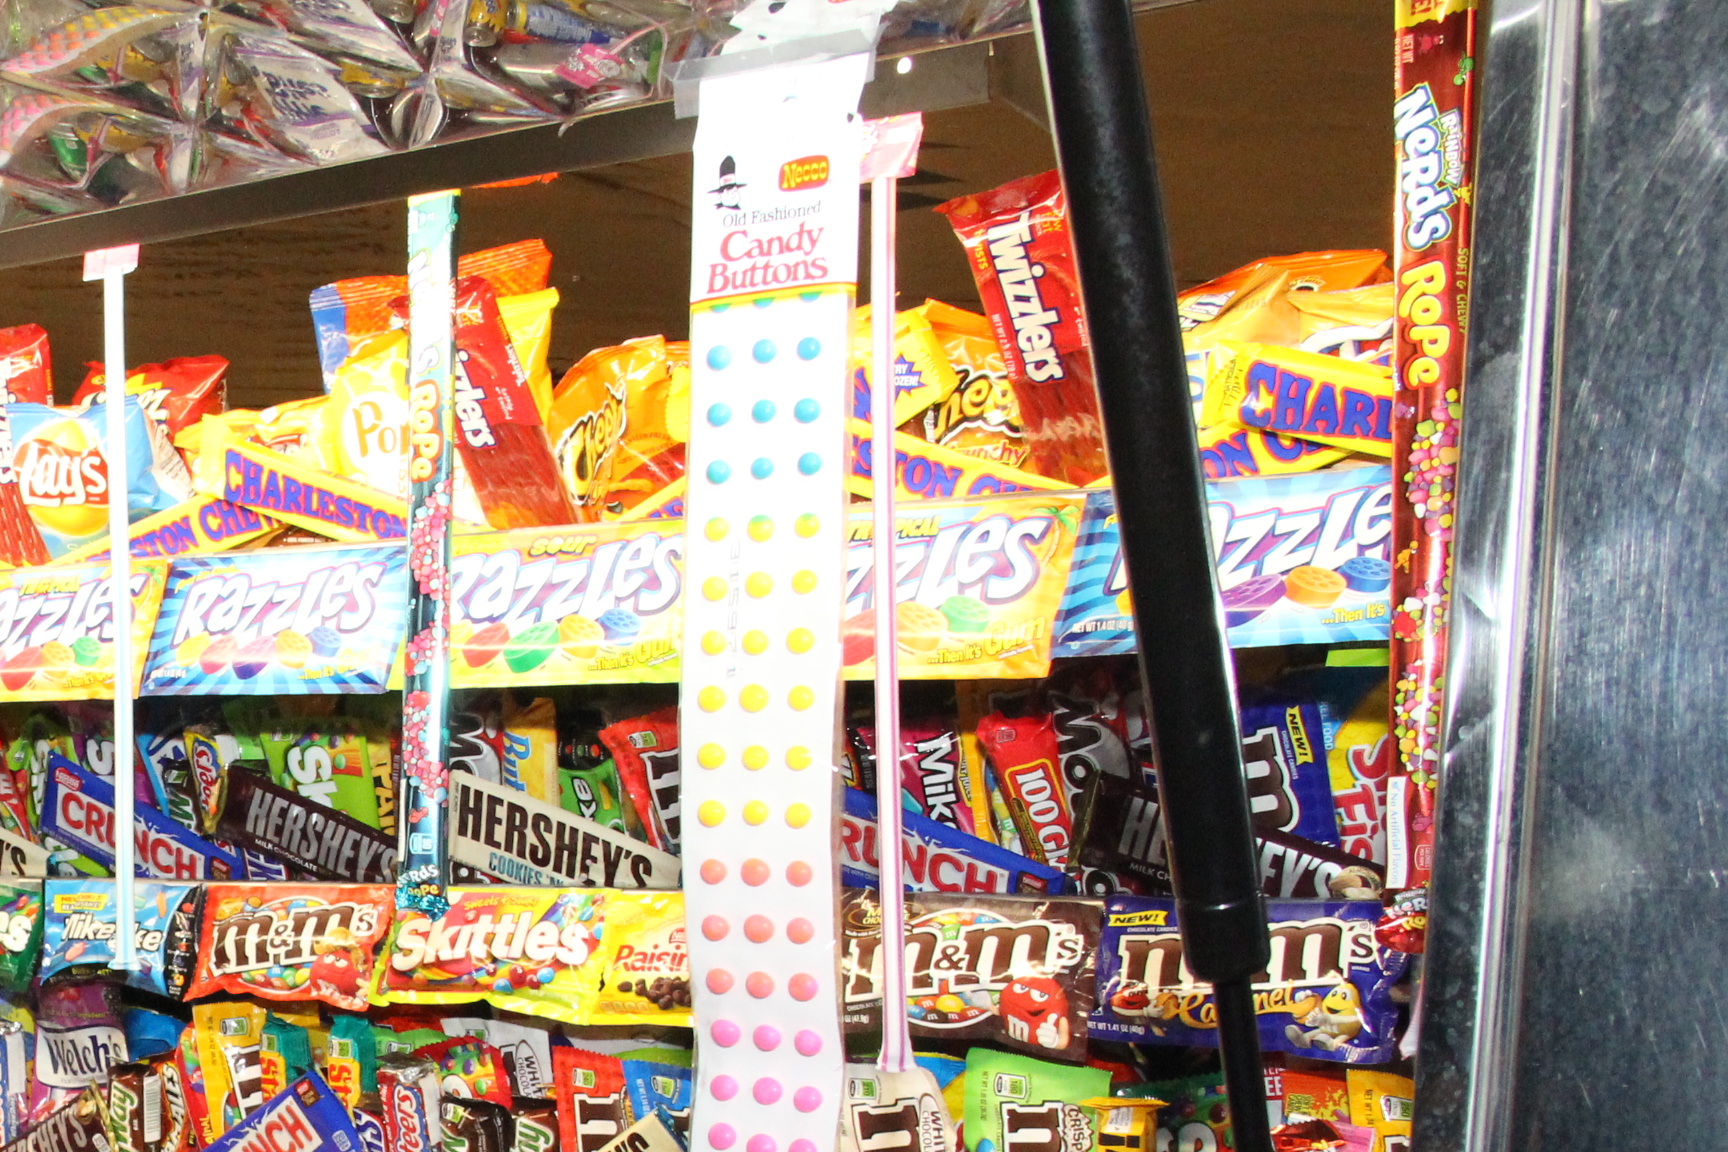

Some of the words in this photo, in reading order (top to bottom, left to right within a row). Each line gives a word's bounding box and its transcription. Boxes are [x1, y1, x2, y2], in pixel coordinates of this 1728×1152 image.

[781, 156, 828, 191] Necco
[722, 212, 747, 228] Old
[751, 200, 822, 224] Fashioned
[718, 221, 824, 262] Candy
[707, 254, 828, 294] Buttons
[1457, 247, 1469, 278] SOFT
[986, 211, 1066, 383] Twizzlers
[20, 446, 106, 507] Lay's
[985, 615, 1047, 656] Gum
[1285, 706, 1314, 765] NEW!
[1014, 767, 1061, 826] 100
[246, 787, 398, 884] HERSHEY'S
[458, 784, 653, 888] HERSHEY'S
[1390, 808, 1400, 849] Artificial
[254, 838, 272, 851] MILK
[274, 847, 318, 872] CHOCOLATE
[488, 852, 543, 886] COOKIES
[1130, 862, 1155, 876] MILK
[1109, 911, 1168, 926] NEW!
[391, 910, 589, 973] Skittles
[46, 1035, 125, 1078] Welch's
